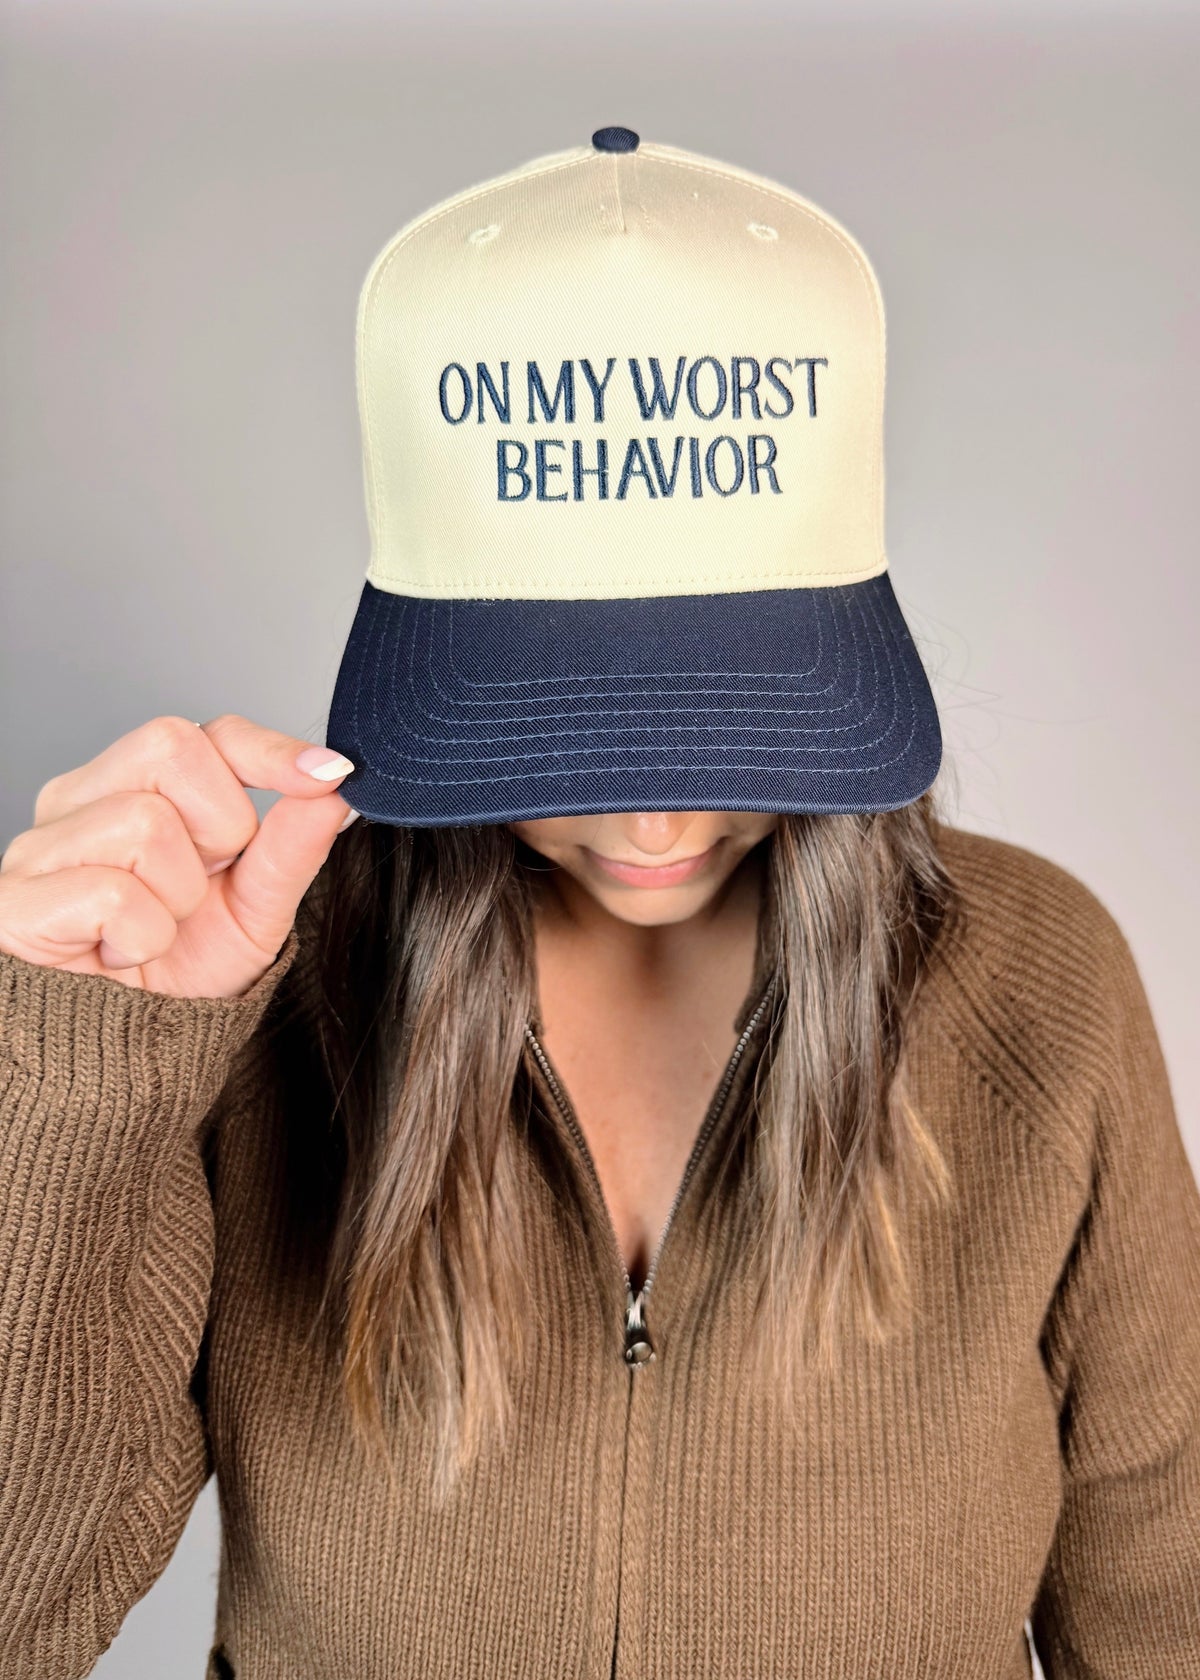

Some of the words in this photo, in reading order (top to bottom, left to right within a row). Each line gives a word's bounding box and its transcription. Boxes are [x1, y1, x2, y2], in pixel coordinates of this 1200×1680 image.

[438, 361, 511, 425] ON
[526, 357, 617, 424] MY
[628, 355, 829, 421] WORST
[496, 434, 783, 502] BEHAVIOR
